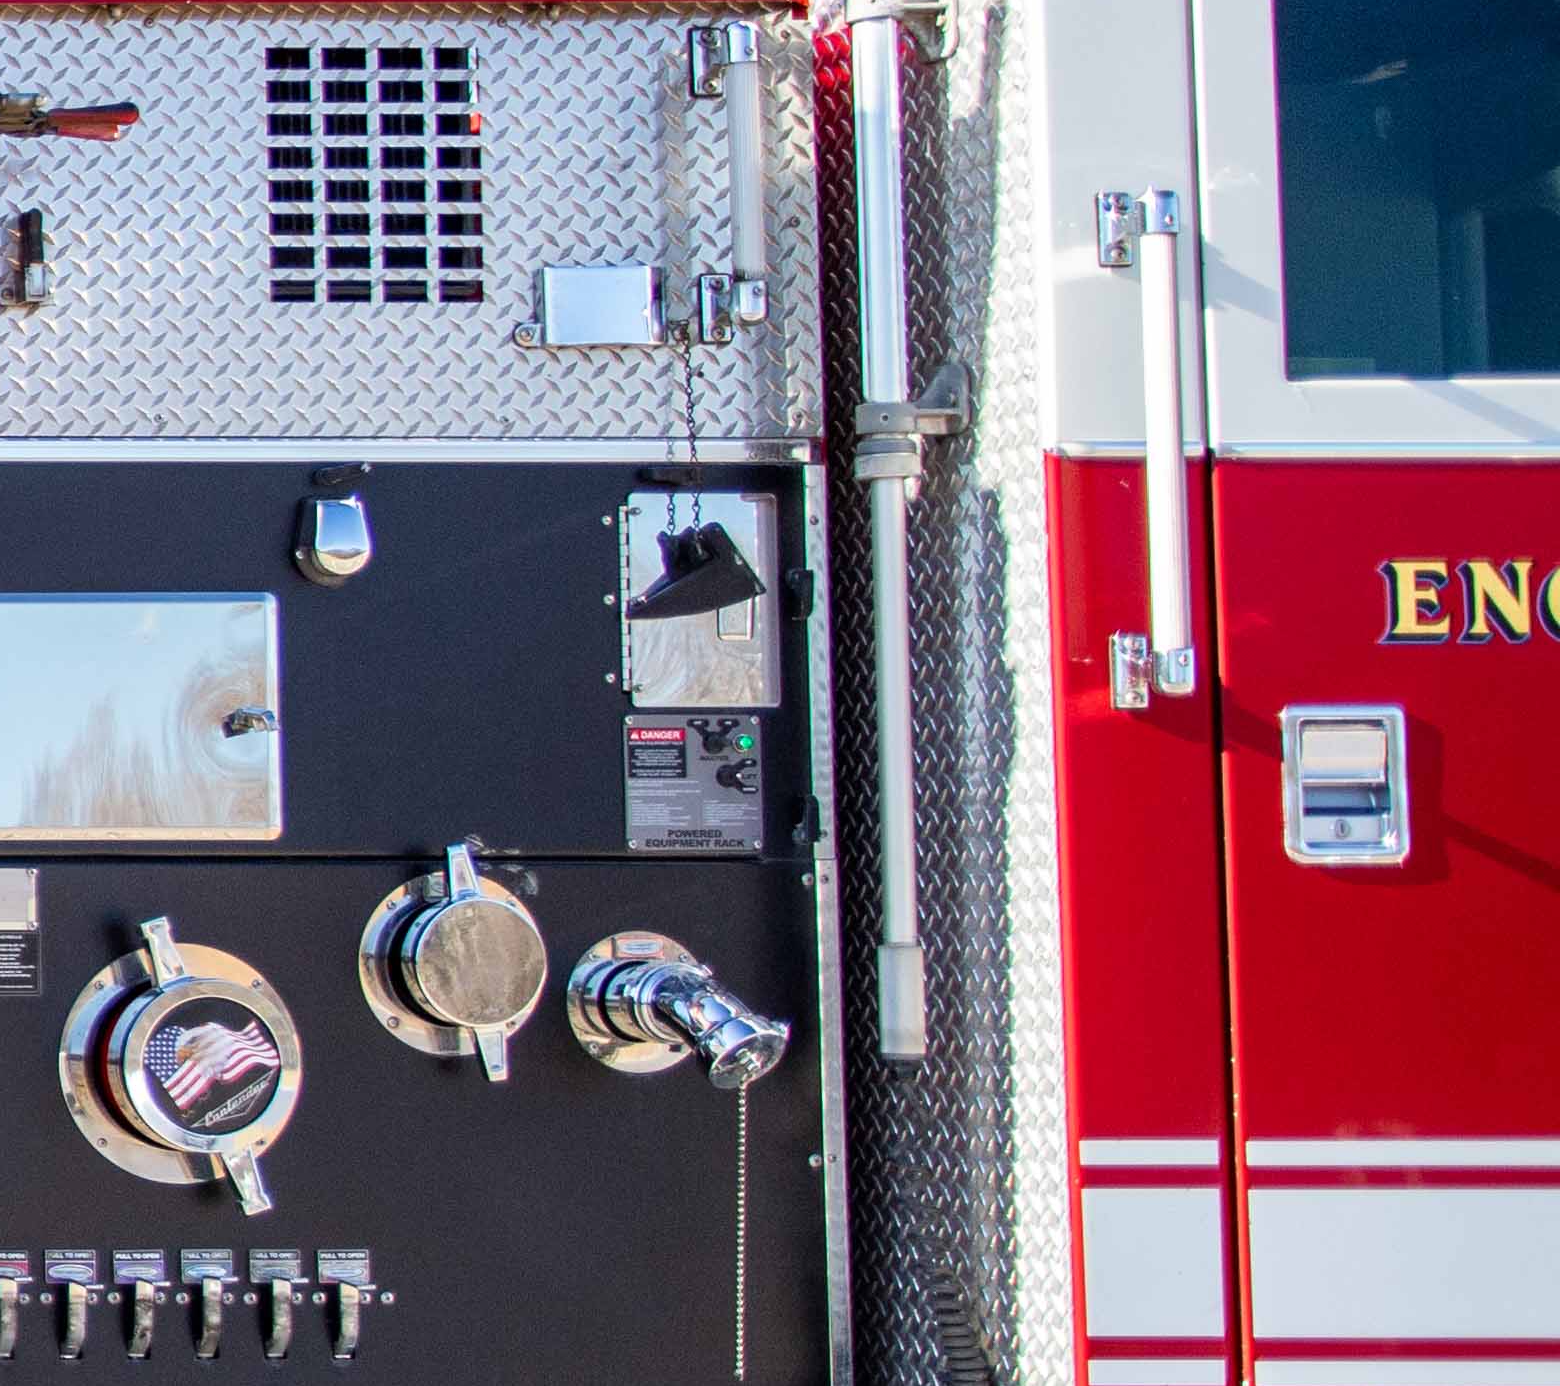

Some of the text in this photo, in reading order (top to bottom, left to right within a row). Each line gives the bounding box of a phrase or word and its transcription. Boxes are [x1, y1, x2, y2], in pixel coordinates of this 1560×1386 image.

[1376, 558, 1560, 644] EN
[640, 729, 681, 740] DANGER
[667, 829, 722, 838] POWERED
[645, 838, 745, 847] EQUIPMENT RACK
